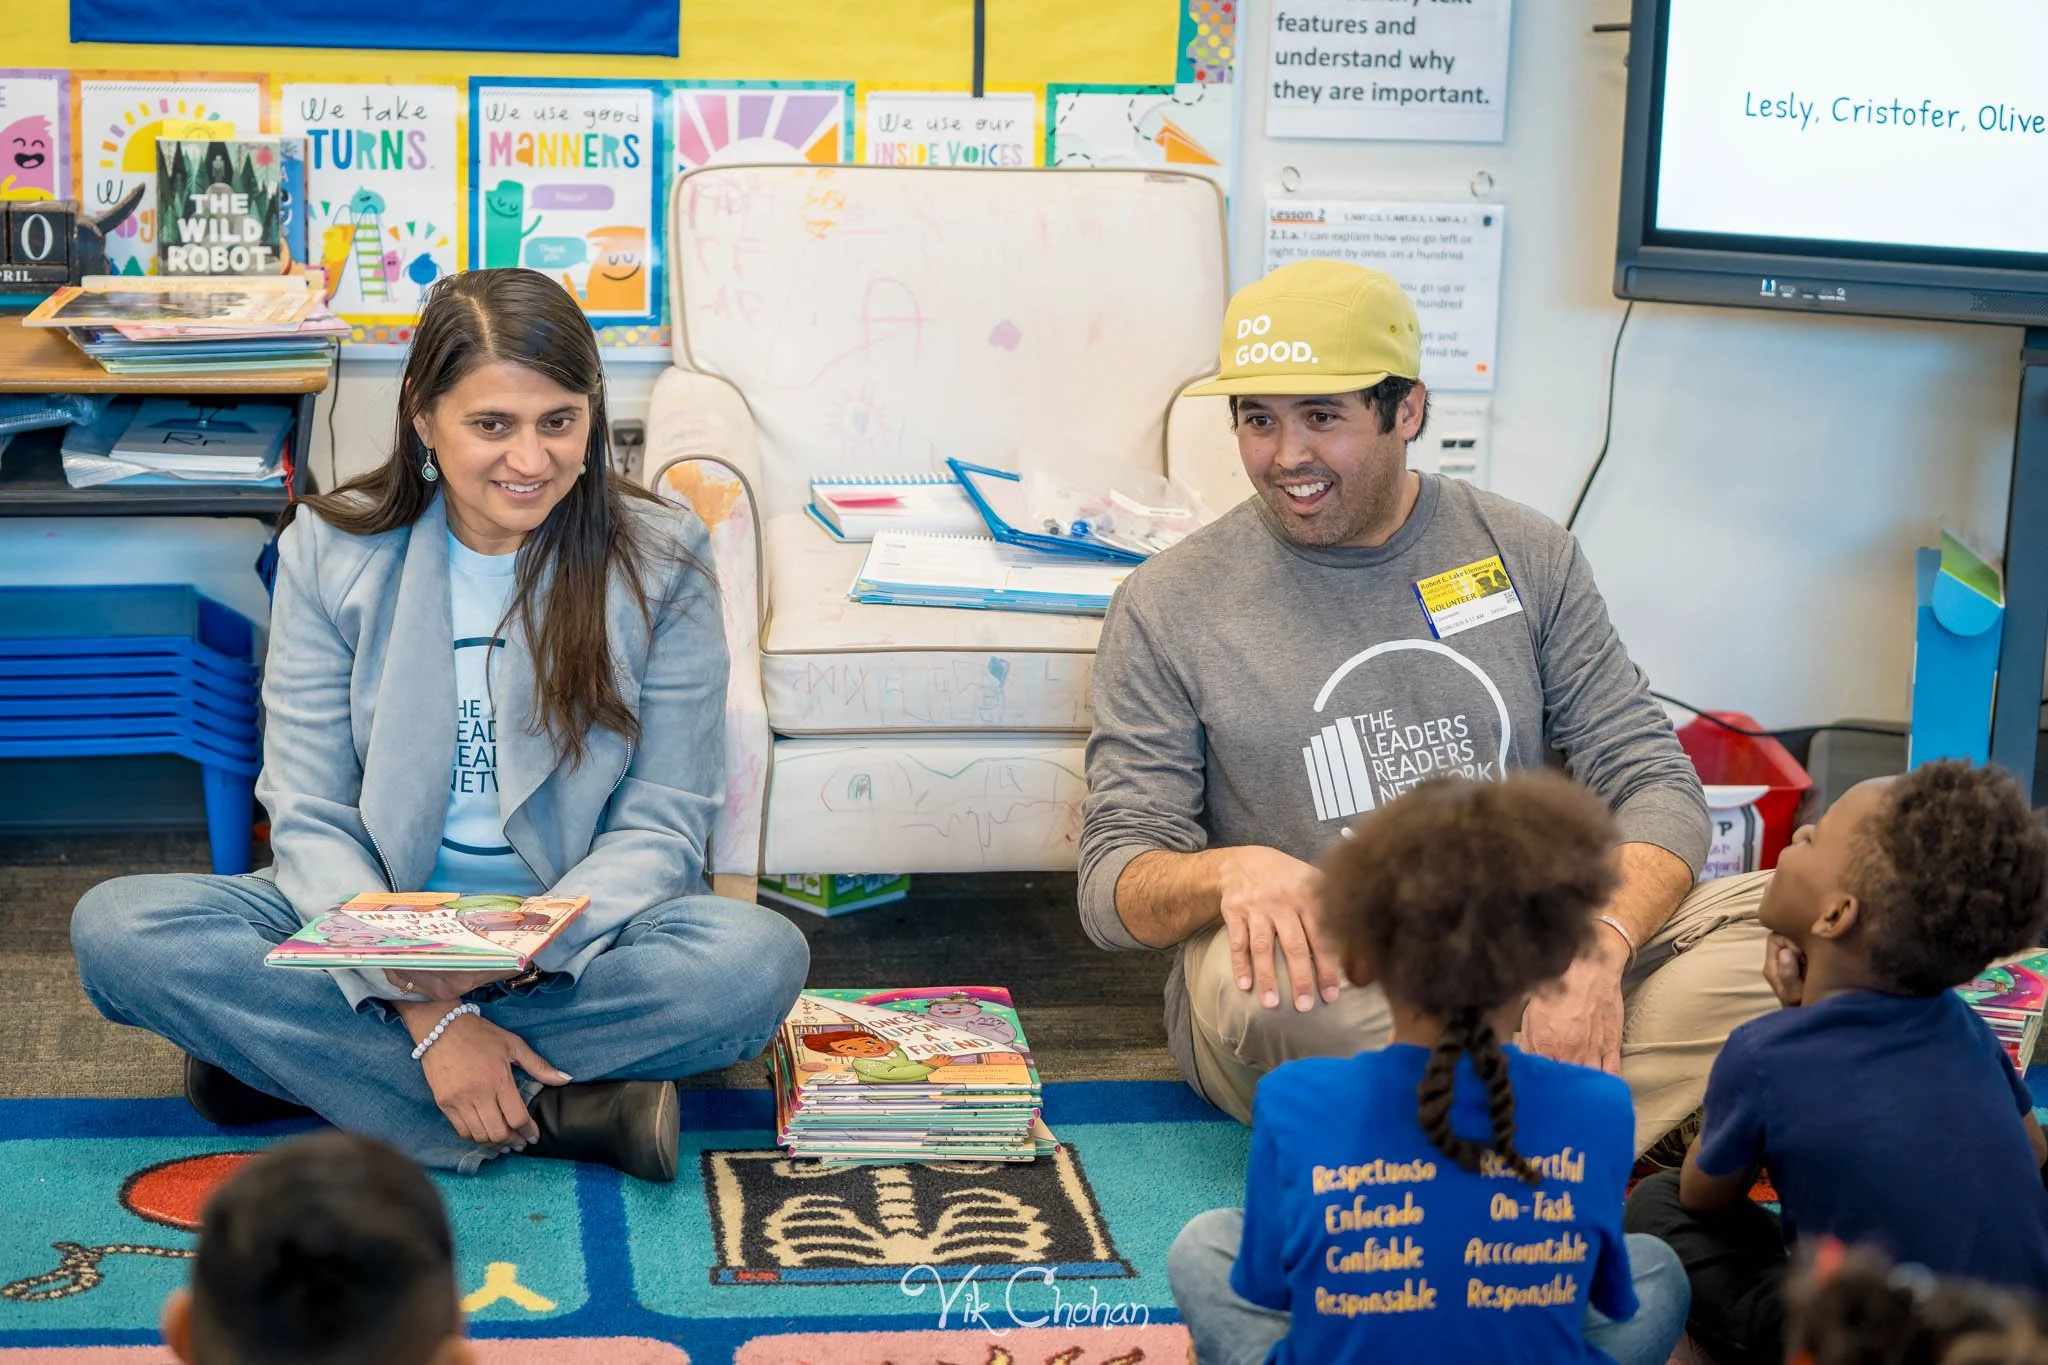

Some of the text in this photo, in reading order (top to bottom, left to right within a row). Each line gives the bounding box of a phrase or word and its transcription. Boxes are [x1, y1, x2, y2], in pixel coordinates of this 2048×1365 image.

[1277, 12, 1416, 35] features and
[1275, 48, 1455, 73] understand why
[1273, 80, 1489, 106] they are important.
[300, 96, 428, 122] We take
[485, 102, 640, 128] We use good
[1745, 91, 1820, 132] Lesly,
[1831, 96, 1967, 133] Cristofer,
[878, 112, 1014, 133] We use our
[190, 193, 249, 215] THE
[178, 219, 264, 244] WILD
[167, 246, 272, 273] ROBOT
[0, 269, 32, 283] RIL
[1236, 314, 1271, 339] DO
[1235, 341, 1320, 367] GOOD.
[1464, 561, 1497, 575] Elementary
[1430, 592, 1478, 613] VOLUNTEER
[457, 700, 481, 718] HE
[1354, 708, 1397, 735] THE
[1363, 714, 1469, 758] LEADERS
[1371, 739, 1475, 783] READERS
[869, 1014, 922, 1029] ONCE
[882, 1021, 949, 1038] UPON
[907, 1038, 992, 1055] FRIEND
[922, 1033, 941, 1042] A
[1325, 1191, 1425, 1235] Enfocado
[1325, 1236, 1425, 1274] Confiable
[1315, 1278, 1438, 1319] Responsable
[1467, 1273, 1578, 1312] Responsible
